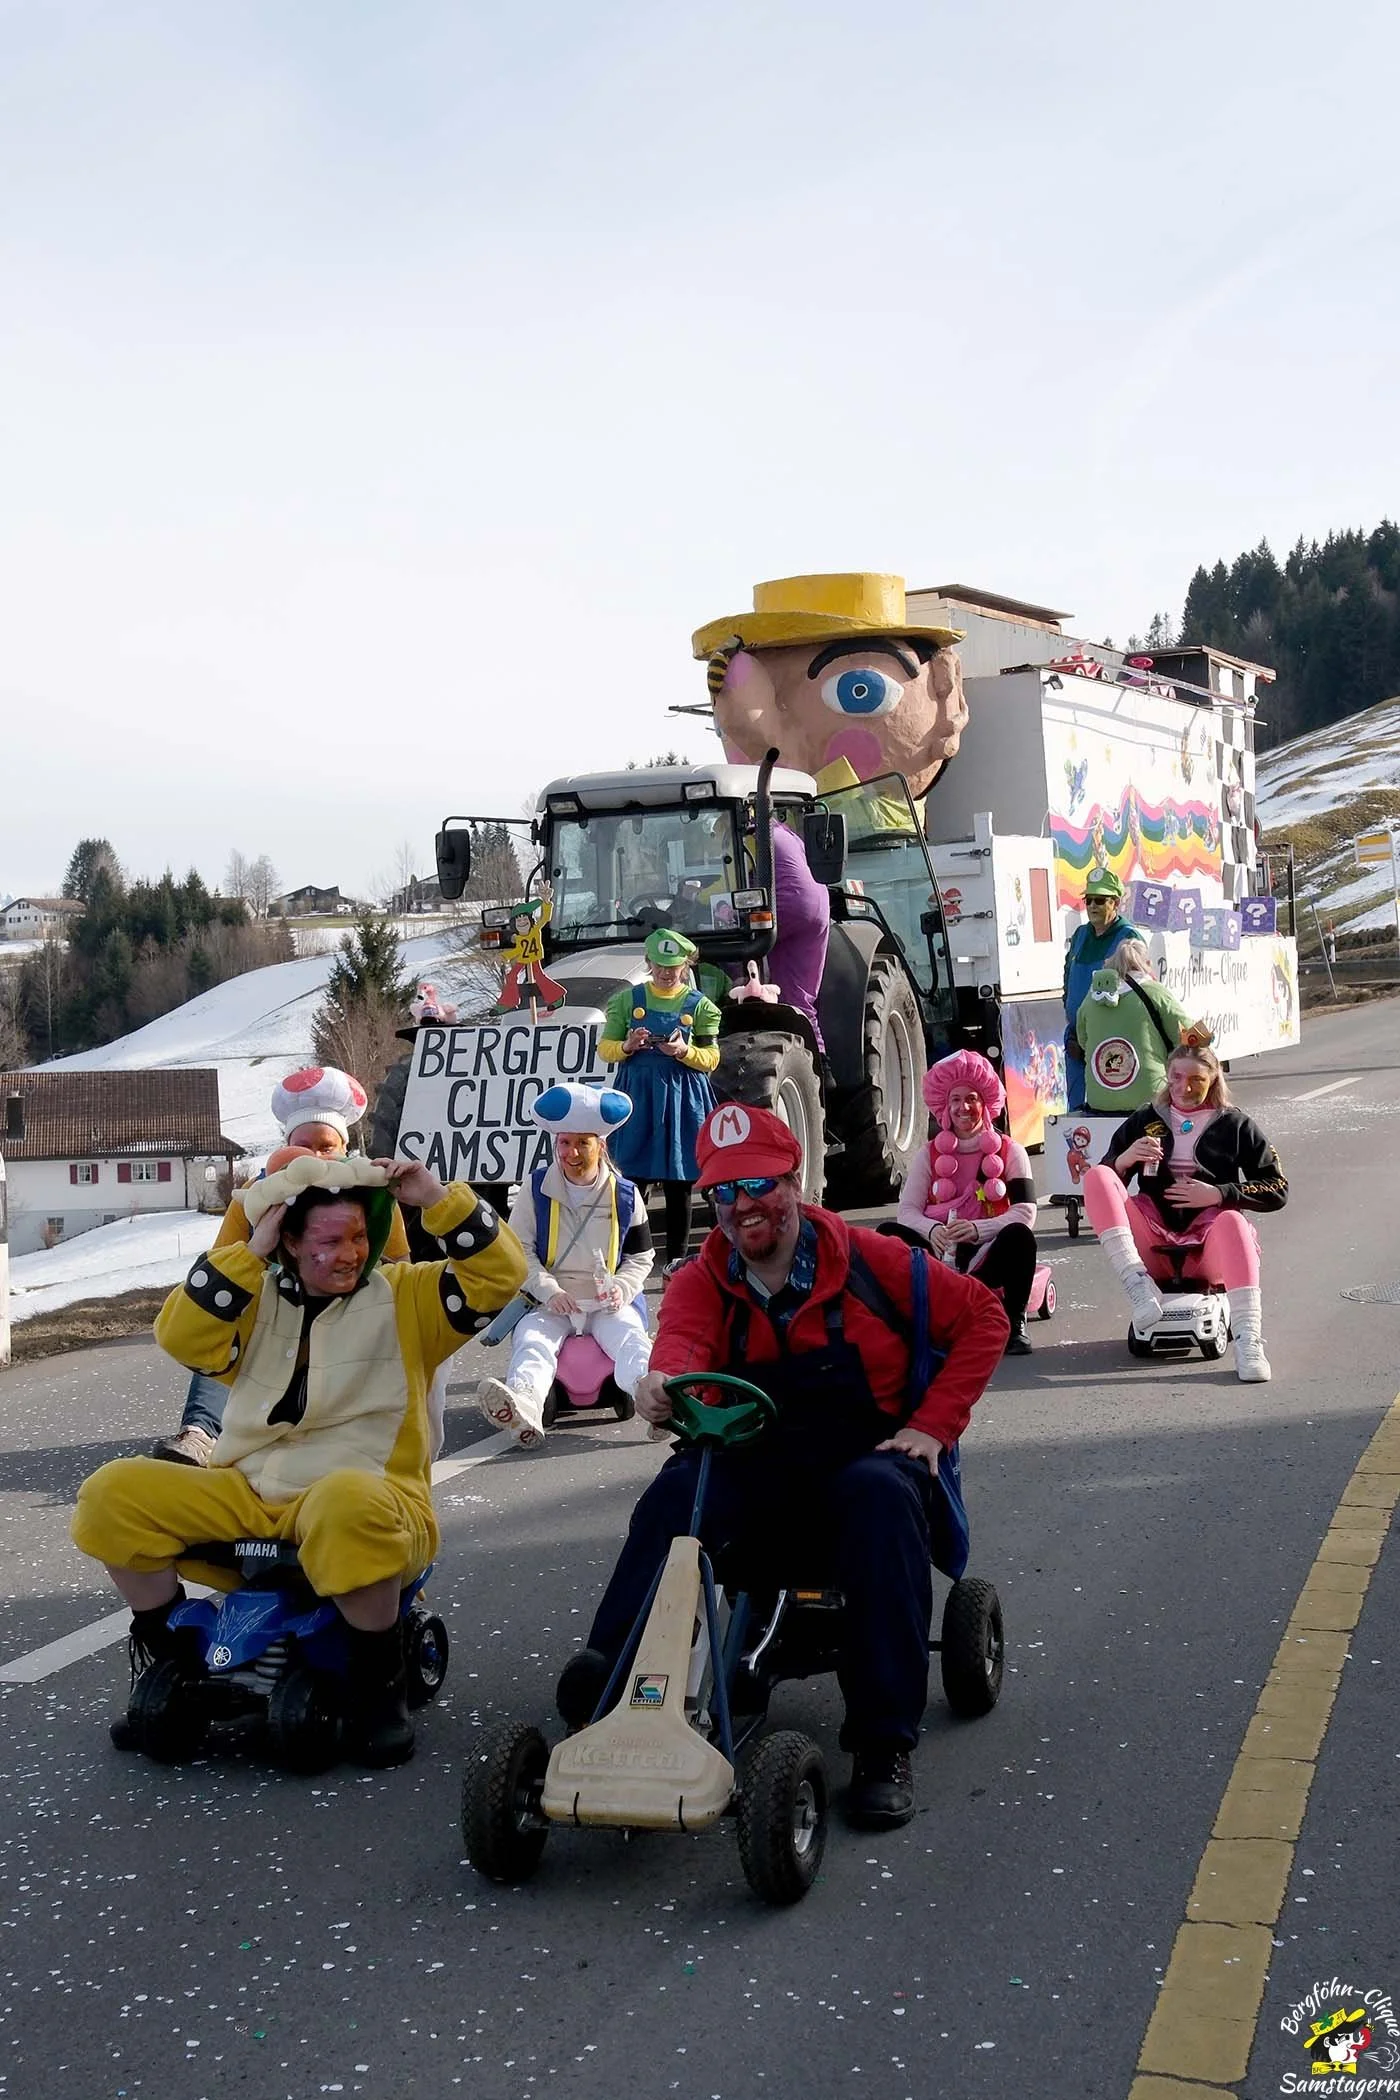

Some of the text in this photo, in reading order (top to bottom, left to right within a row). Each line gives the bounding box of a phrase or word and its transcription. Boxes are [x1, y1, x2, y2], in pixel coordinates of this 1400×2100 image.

[520, 938, 539, 957] 24
[663, 941, 675, 954] L
[418, 1024, 615, 1078] BERGFÖH
[447, 1076, 606, 1129] CLIQ
[718, 1110, 742, 1141] M
[399, 1130, 554, 1181] SAMSTA
[235, 1543, 278, 1558] YAMAHA
